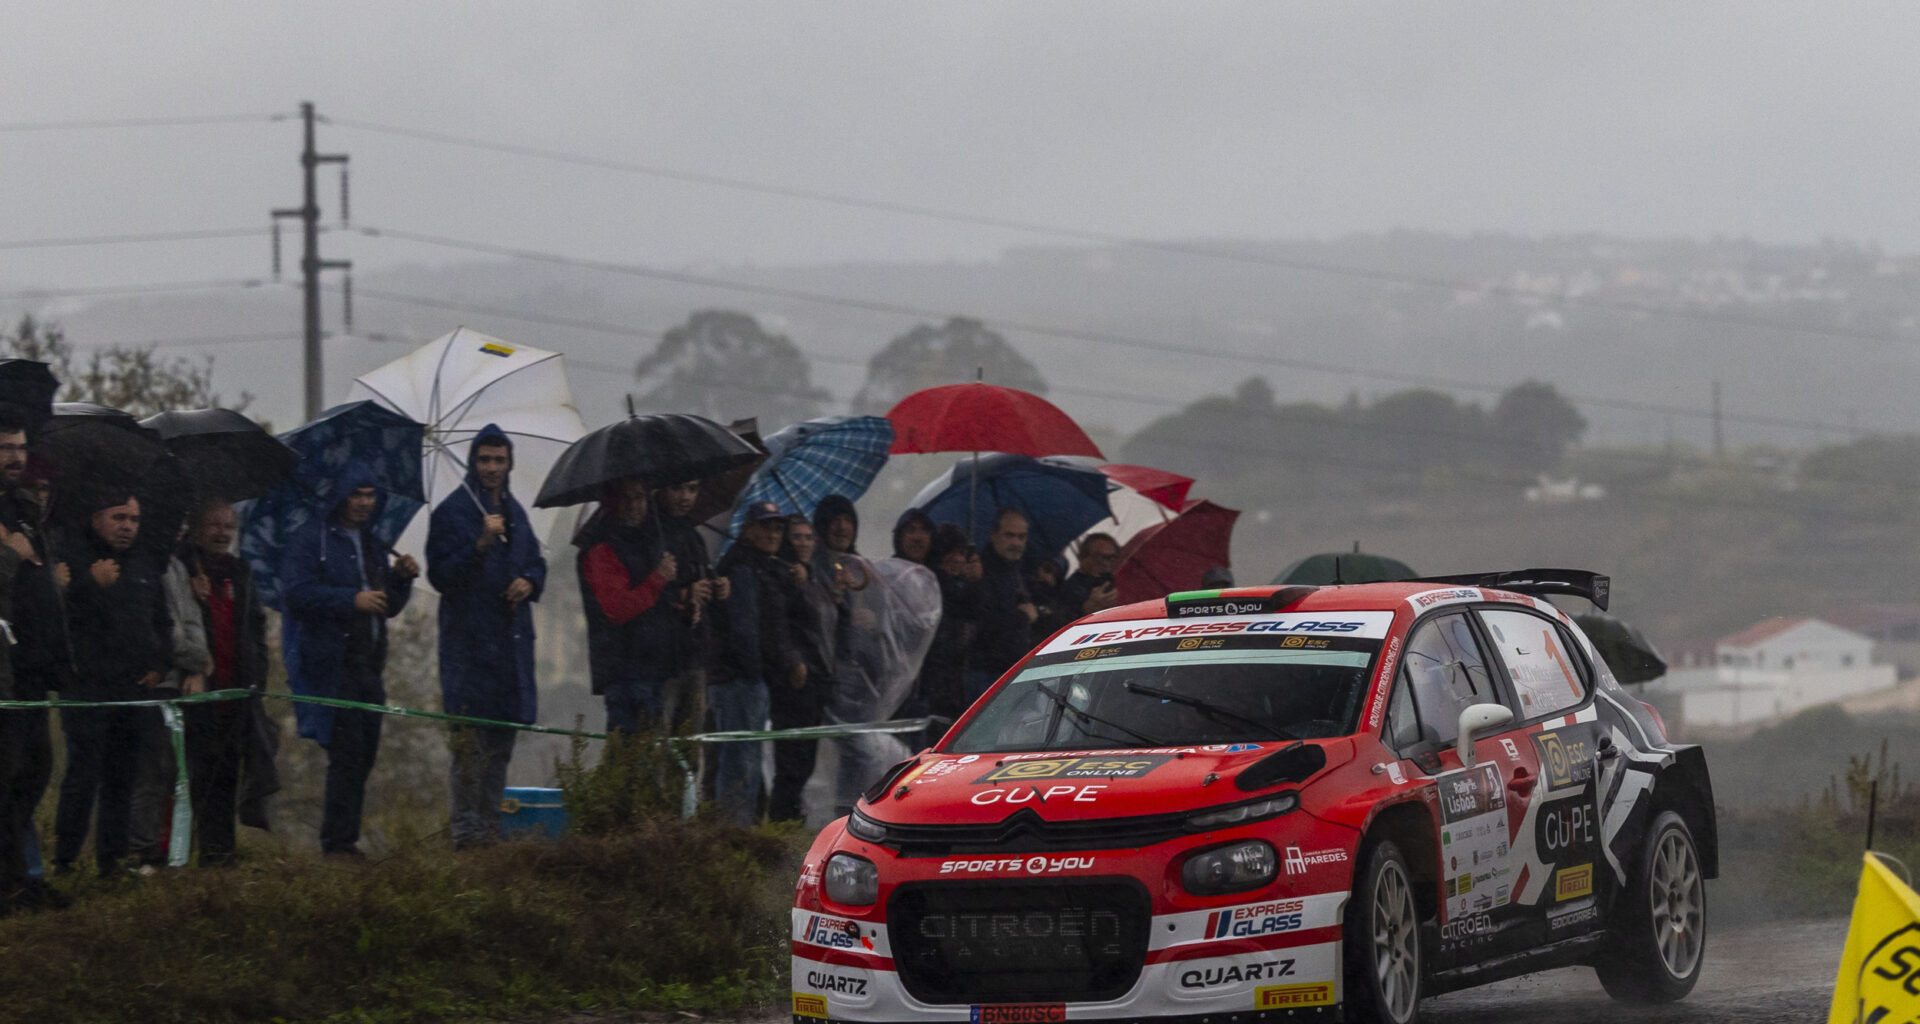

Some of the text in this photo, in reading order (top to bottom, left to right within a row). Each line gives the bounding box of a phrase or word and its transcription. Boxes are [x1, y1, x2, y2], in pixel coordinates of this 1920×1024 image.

[1543, 630, 1582, 698] 1
[1566, 742, 1589, 765] ESC
[1066, 769, 1139, 777] ONLINE
[1075, 761, 1153, 770] ESC
[1448, 794, 1477, 814] Lisboa
[1304, 852, 1348, 866] PAREDES
[1559, 869, 1590, 895] PIRELLI
[1234, 901, 1304, 920] EXPRESS
[1232, 913, 1303, 937] GLASS
[816, 930, 854, 948] GLASS
[807, 970, 868, 996] QUARTZ
[1181, 958, 1296, 988] QUARTZ
[795, 996, 826, 1015] PIRELLI
[1262, 986, 1329, 1006] PIRELLI
[982, 1005, 1062, 1022] BN80SC
